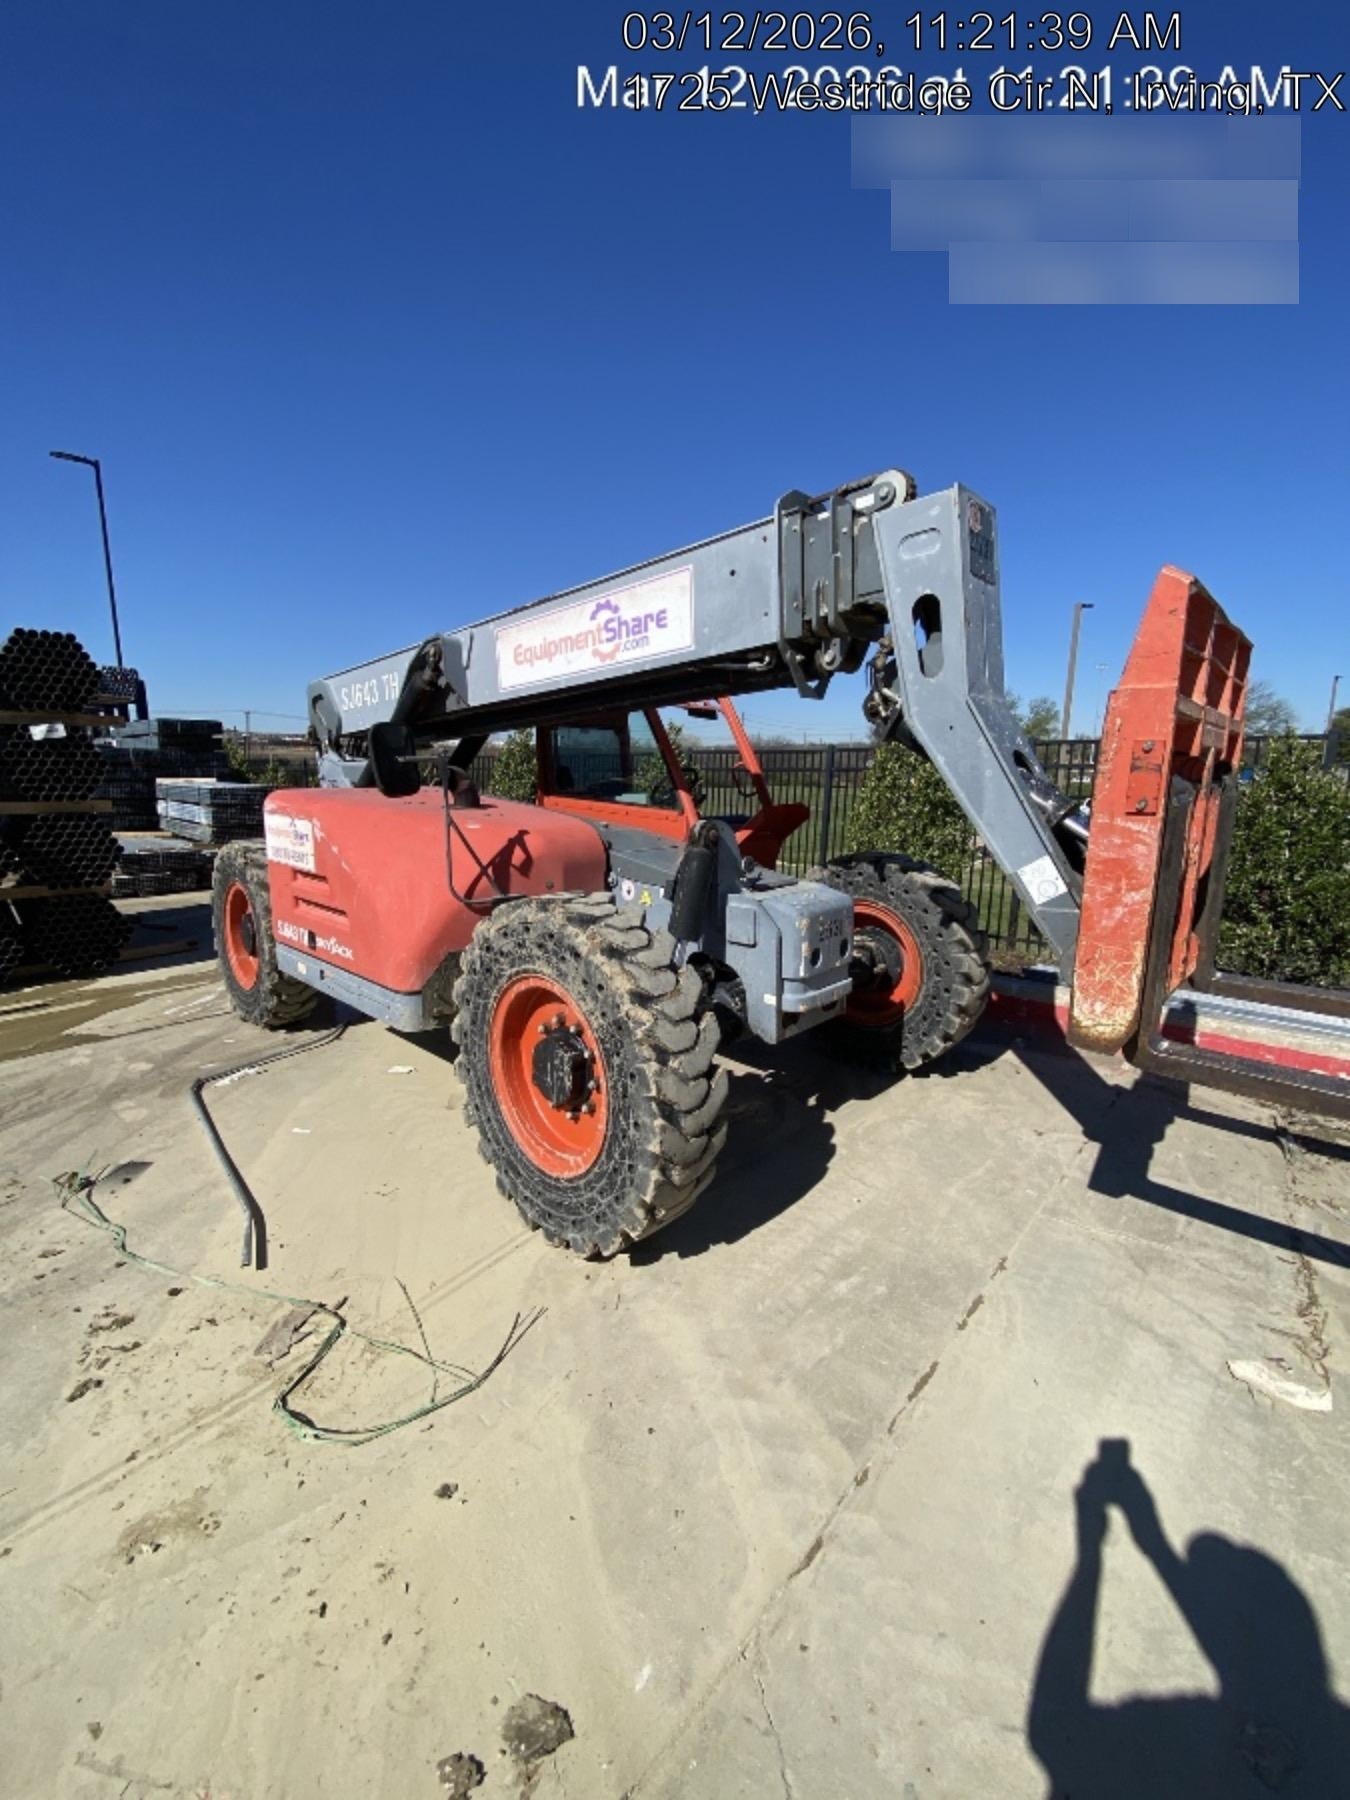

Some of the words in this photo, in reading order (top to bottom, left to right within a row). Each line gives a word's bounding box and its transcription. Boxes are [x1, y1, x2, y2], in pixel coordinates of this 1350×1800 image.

[513, 609, 668, 667] EquipmentShare
[341, 679, 379, 711] SJ643
[382, 671, 399, 702] TH
